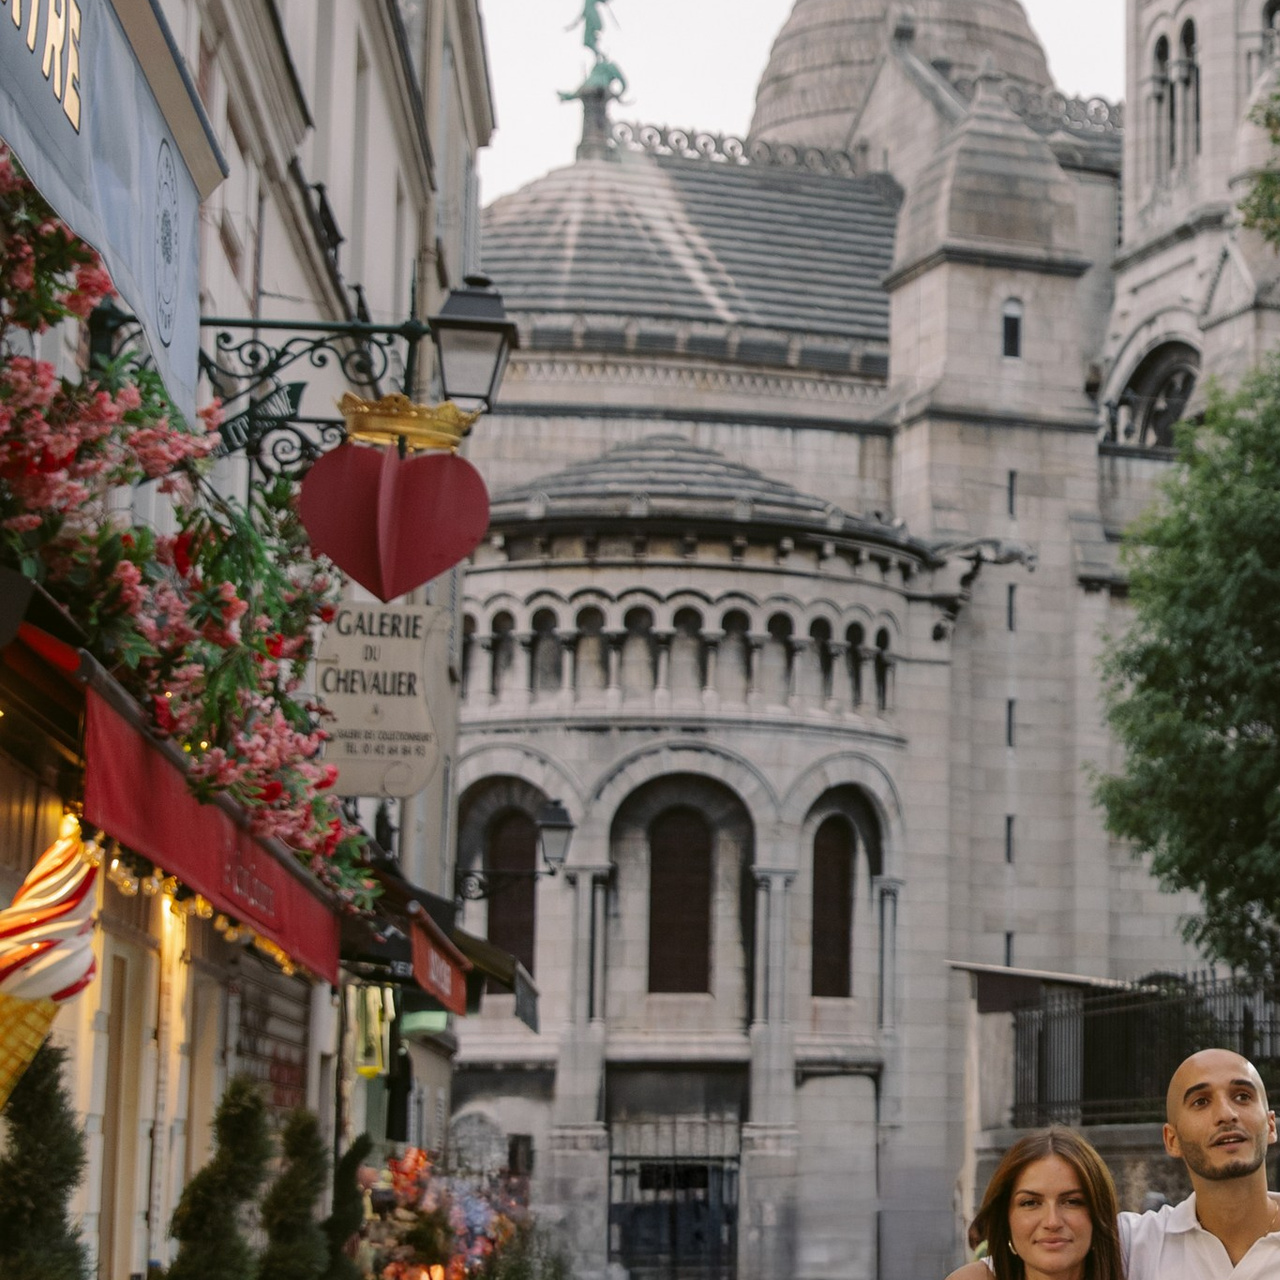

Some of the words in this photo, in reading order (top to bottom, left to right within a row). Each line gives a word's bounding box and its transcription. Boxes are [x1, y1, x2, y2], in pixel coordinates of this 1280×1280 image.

[336, 610, 423, 639] GALERIE
[364, 644, 381, 661] DU
[321, 667, 418, 697] CHEVALIER
